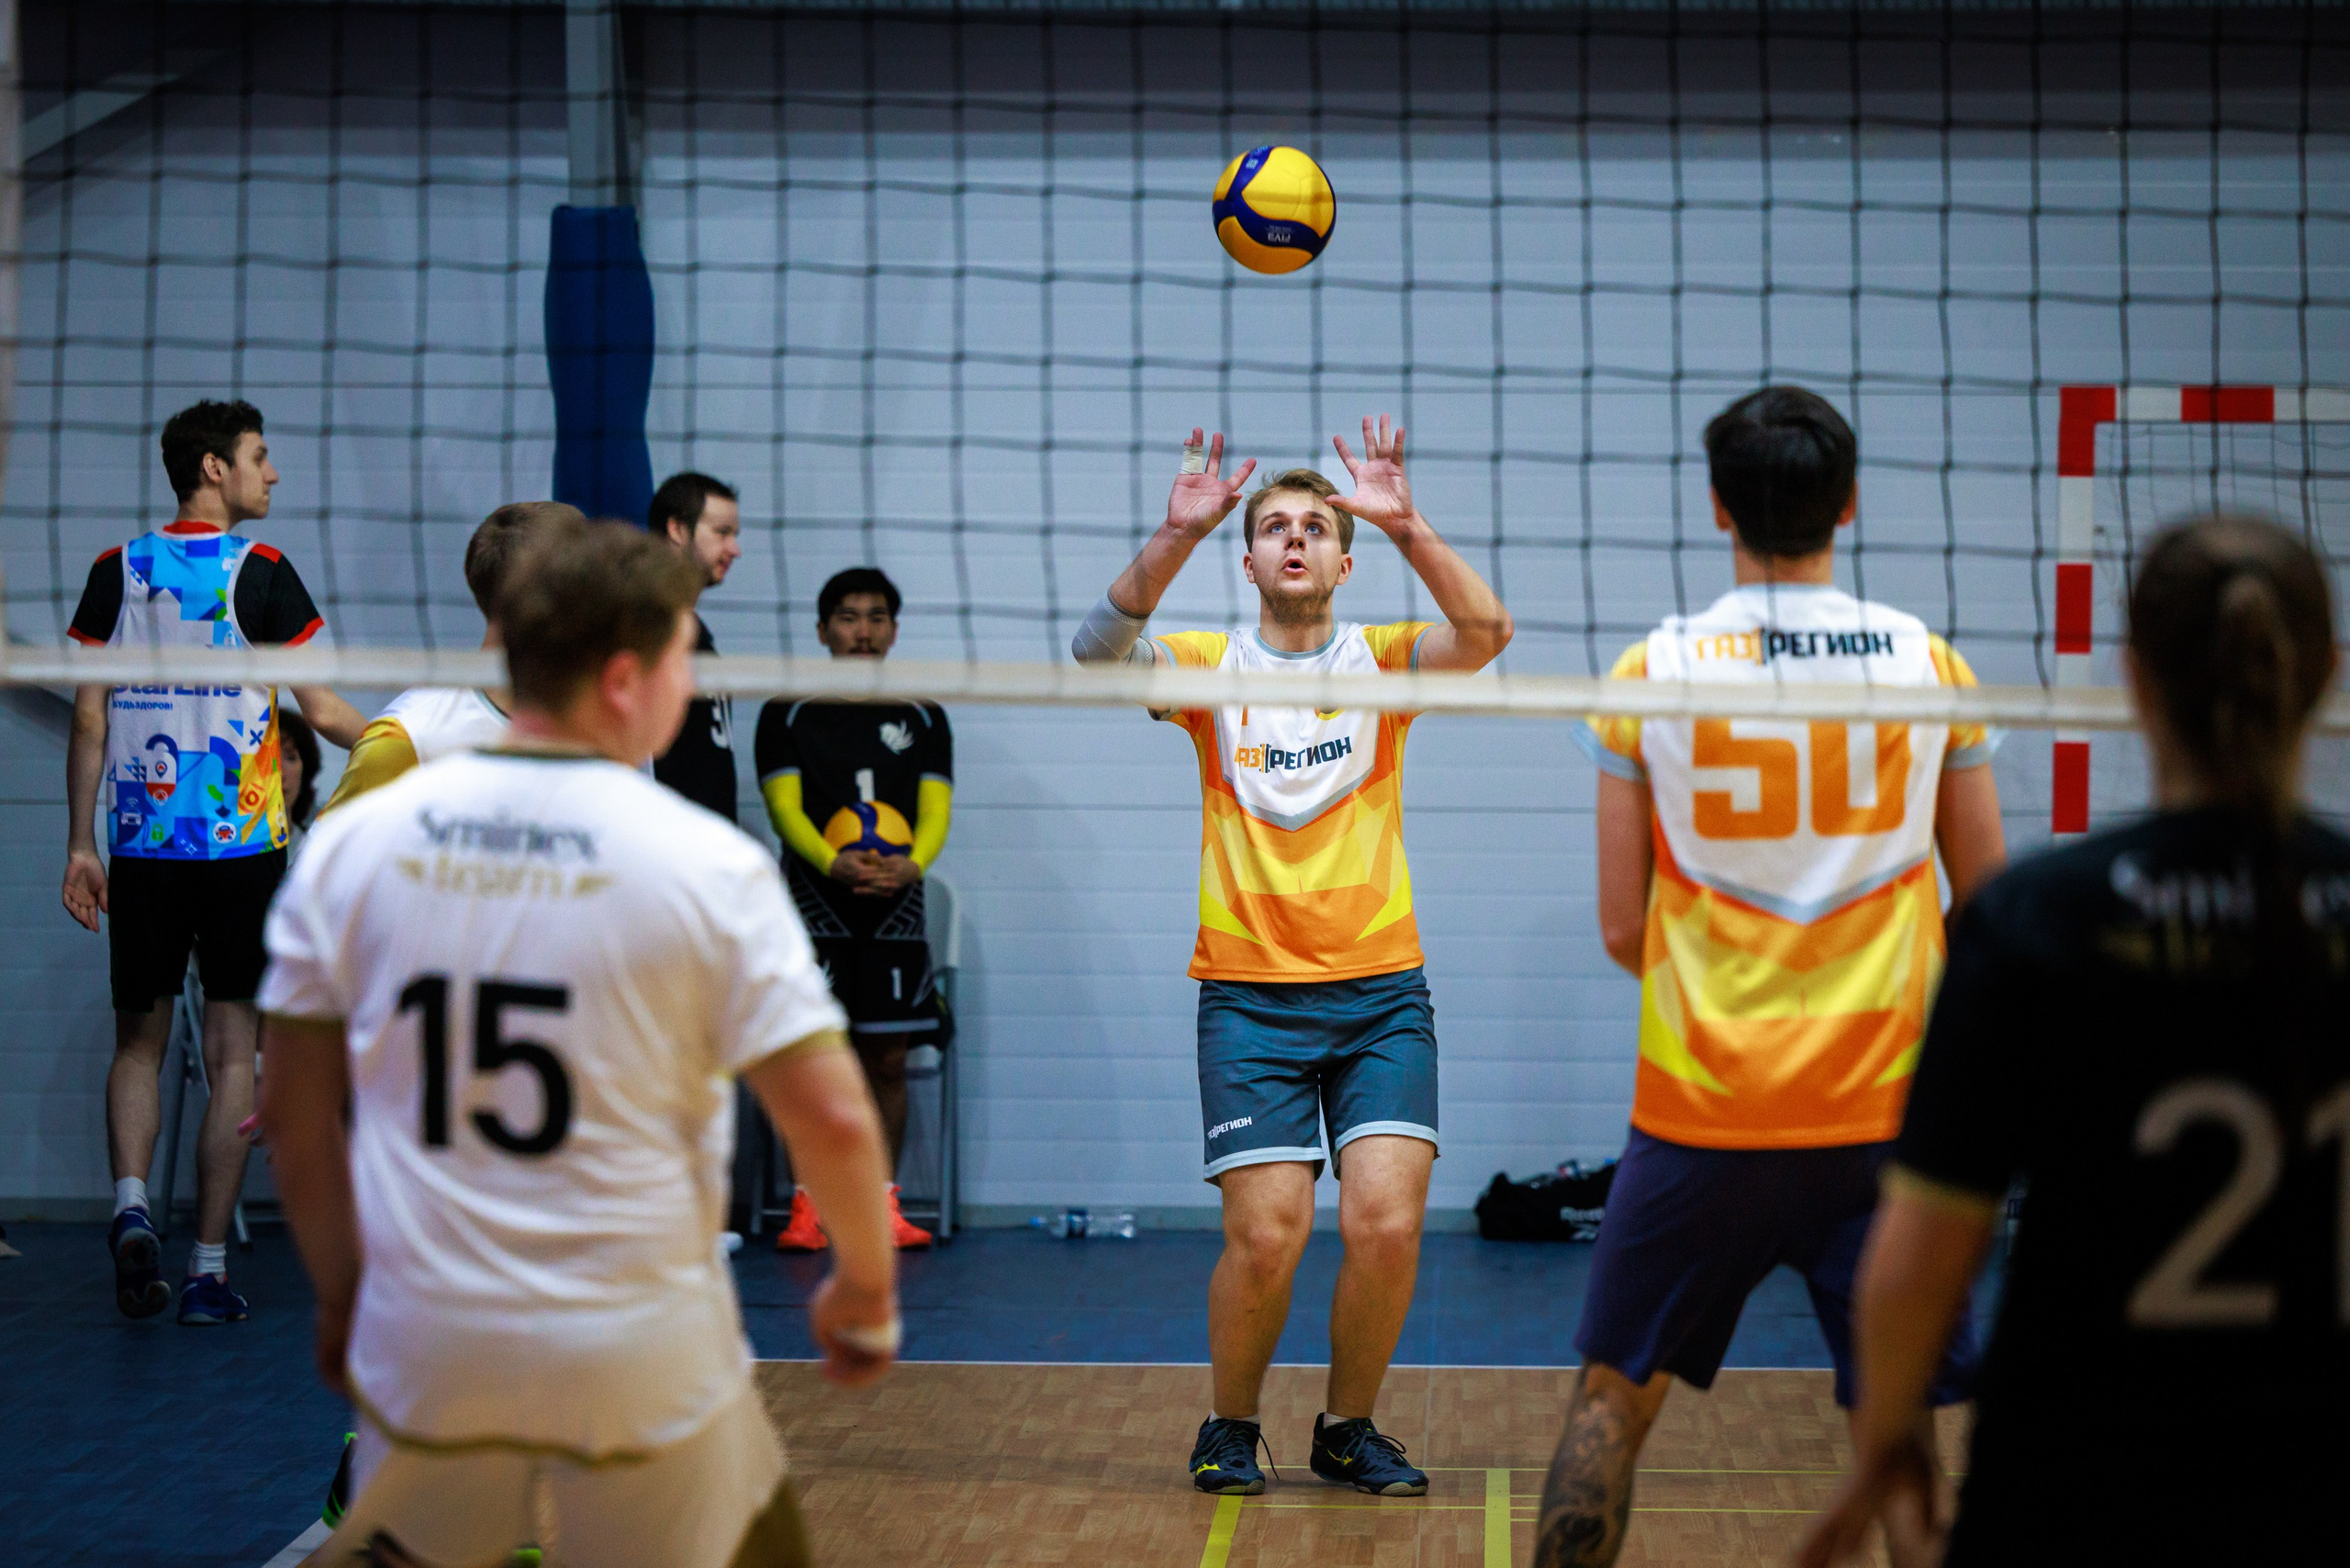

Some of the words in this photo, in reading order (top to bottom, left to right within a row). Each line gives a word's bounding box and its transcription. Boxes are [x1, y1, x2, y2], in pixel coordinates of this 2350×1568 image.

[1768, 632, 1894, 659] РЕГИОН
[1270, 736, 1352, 770] РЕГИОН
[855, 767, 876, 802] 1
[1693, 719, 1910, 838] 50
[890, 966, 902, 1001] 1
[400, 973, 573, 1154] 15
[1216, 1116, 1252, 1135] РЕГИОН
